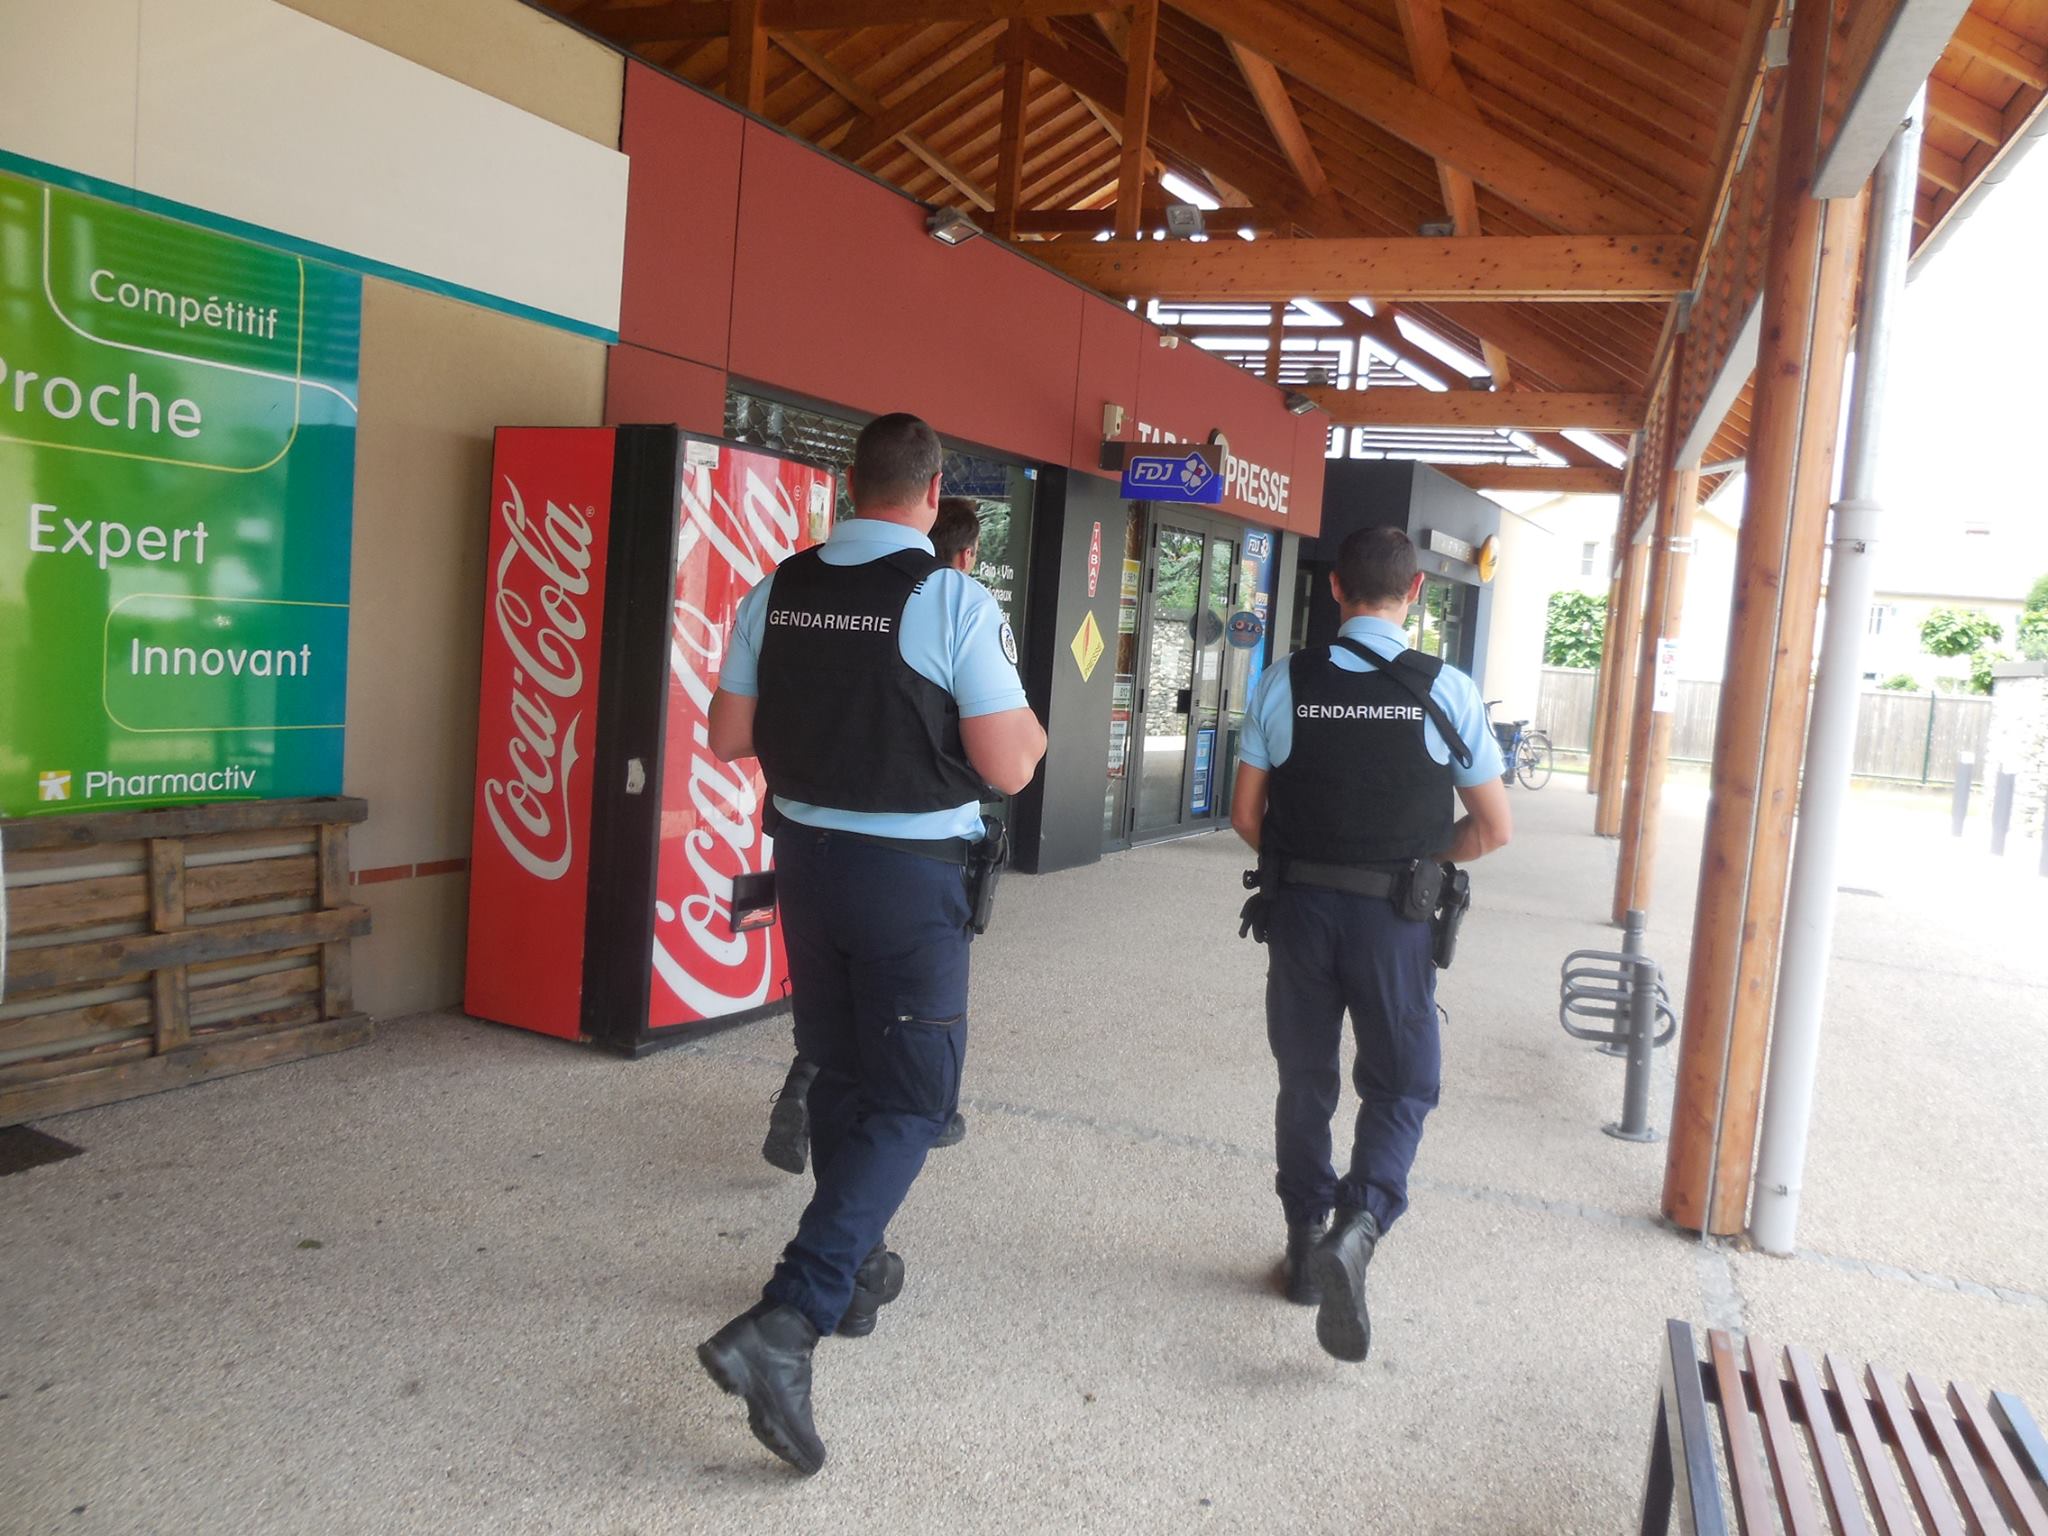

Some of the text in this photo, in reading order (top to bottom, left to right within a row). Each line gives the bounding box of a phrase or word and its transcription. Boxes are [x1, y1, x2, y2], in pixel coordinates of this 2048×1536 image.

[90, 269, 278, 340] Compétitif
[0, 356, 201, 438] roche
[1134, 462, 1174, 481] FDJ
[1224, 455, 1290, 514] PRESSE
[29, 503, 209, 570] Expert
[1089, 528, 1099, 591] TABAC
[769, 610, 892, 633] GENDARMERIE
[131, 637, 311, 677] Innovant
[1296, 704, 1423, 721] GENDARMERIE
[85, 764, 257, 799] Pharmactiv
